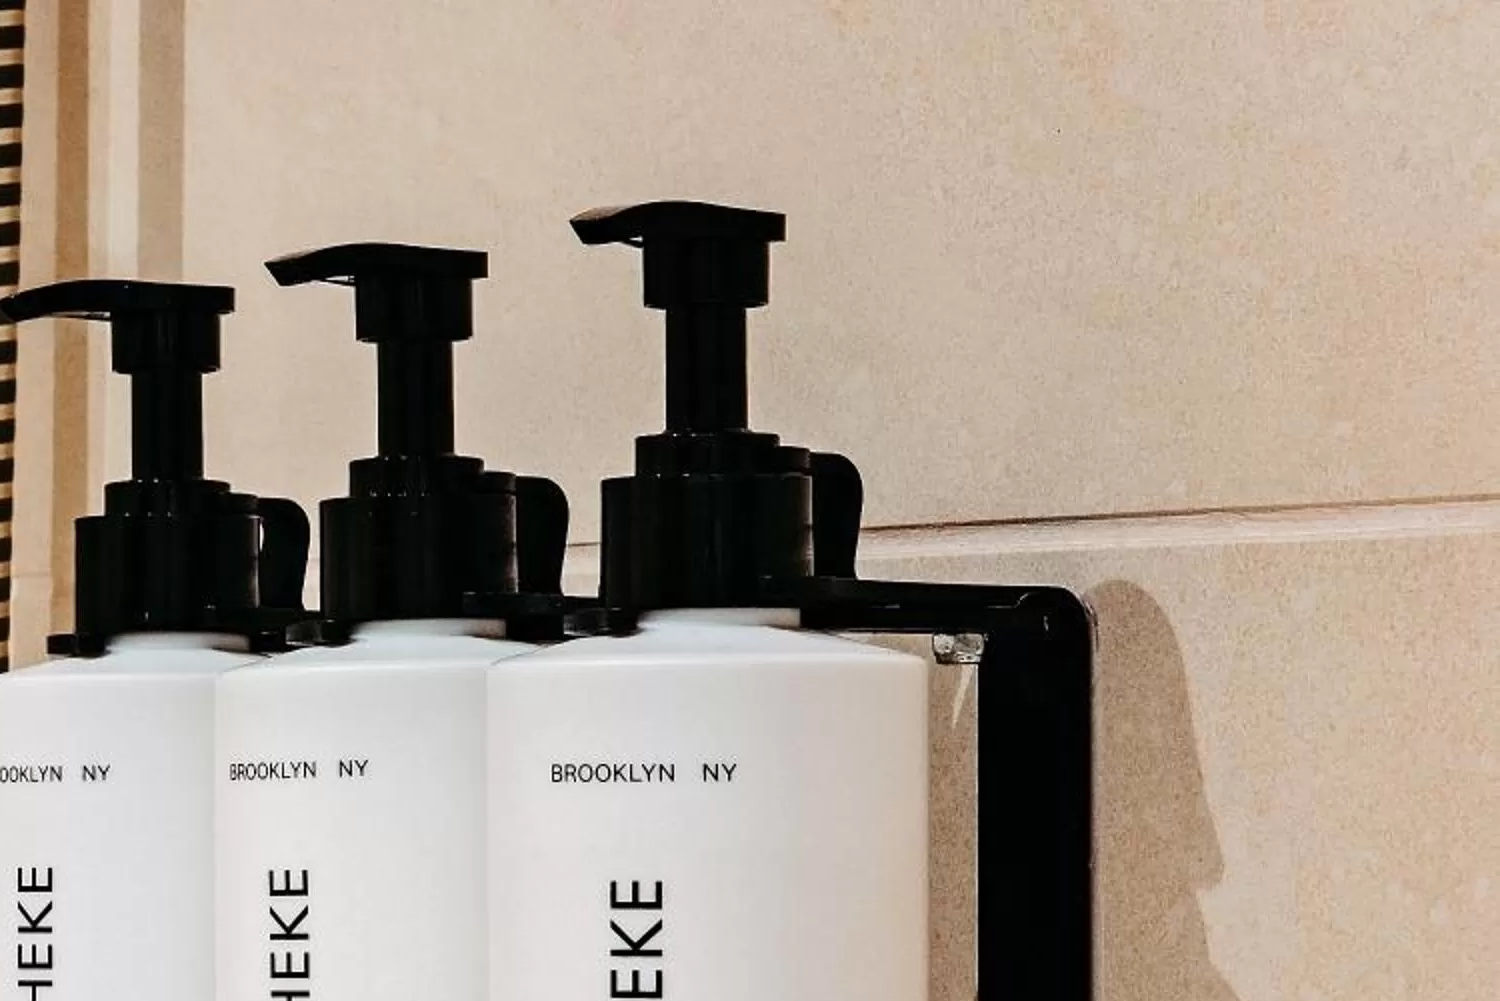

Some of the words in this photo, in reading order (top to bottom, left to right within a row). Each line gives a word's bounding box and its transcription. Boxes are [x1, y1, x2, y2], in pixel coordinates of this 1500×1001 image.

[82, 764, 111, 782] NY
[229, 760, 317, 781] BROOKLYN
[339, 759, 369, 779] NY
[551, 763, 676, 784] BROOKLYN
[702, 762, 738, 783] NY
